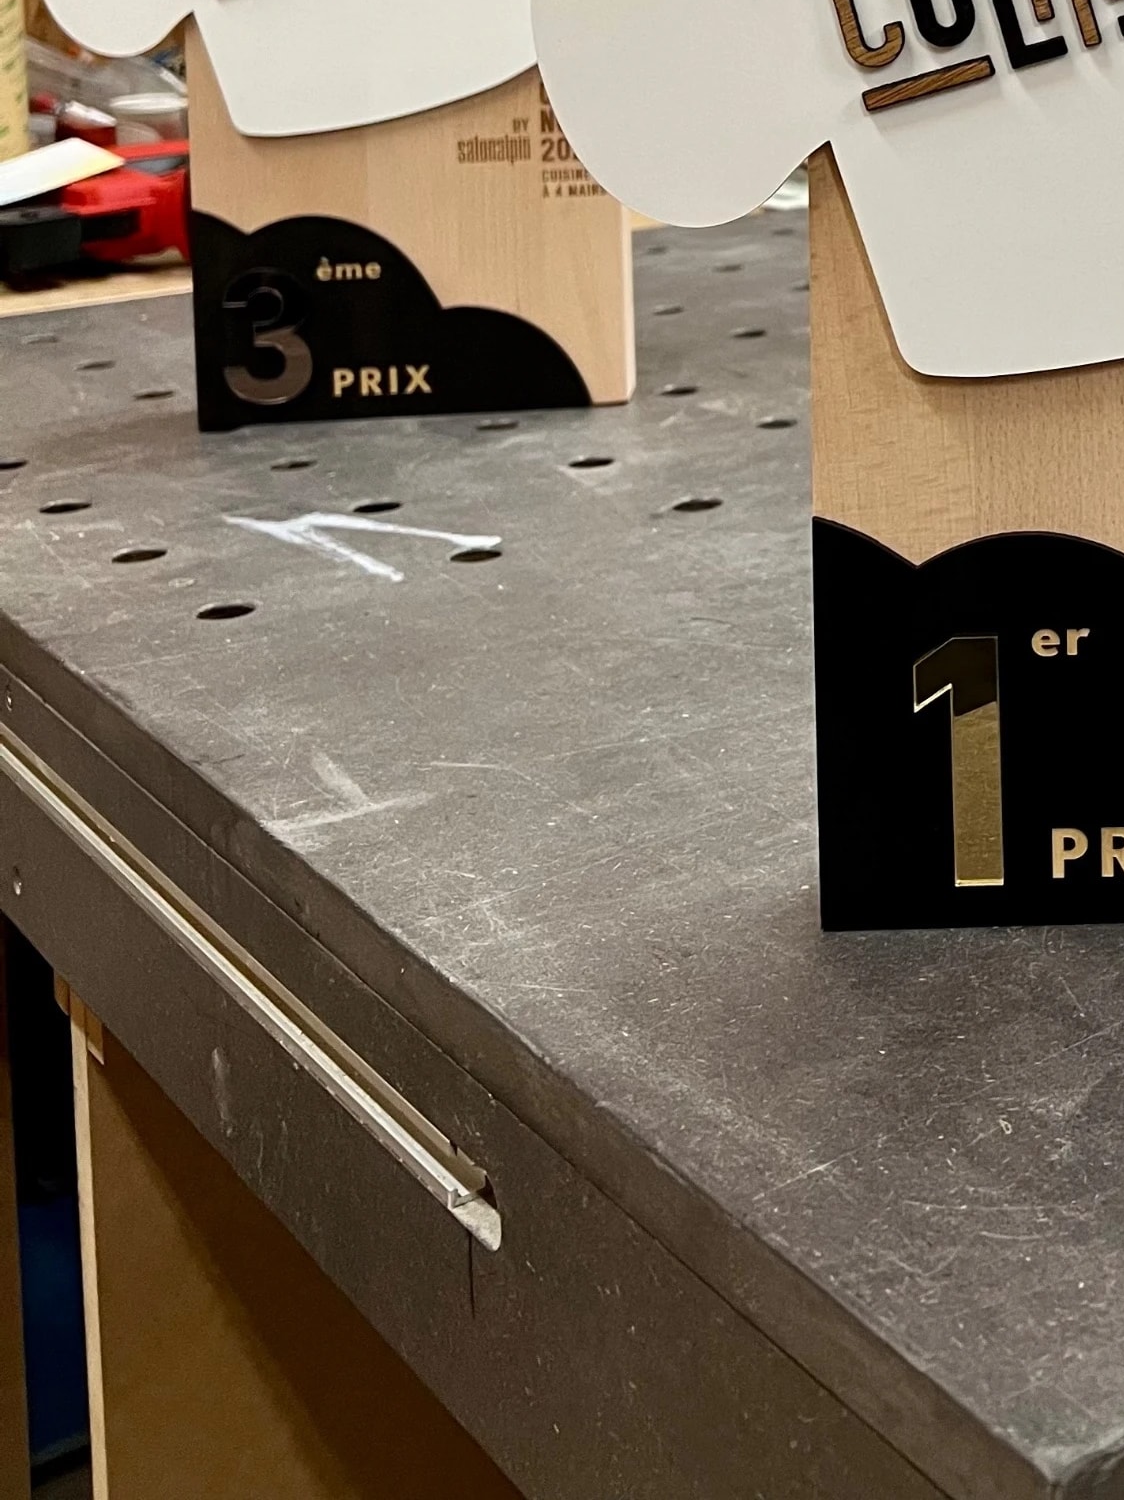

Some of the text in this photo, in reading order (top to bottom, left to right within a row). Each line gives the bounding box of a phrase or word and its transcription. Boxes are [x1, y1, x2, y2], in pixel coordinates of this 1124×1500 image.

[513, 118, 530, 133] BY
[540, 137, 579, 163] 20
[222, 255, 382, 406] 3 ème
[331, 363, 433, 399] PRIX
[912, 627, 1092, 888] 1 er
